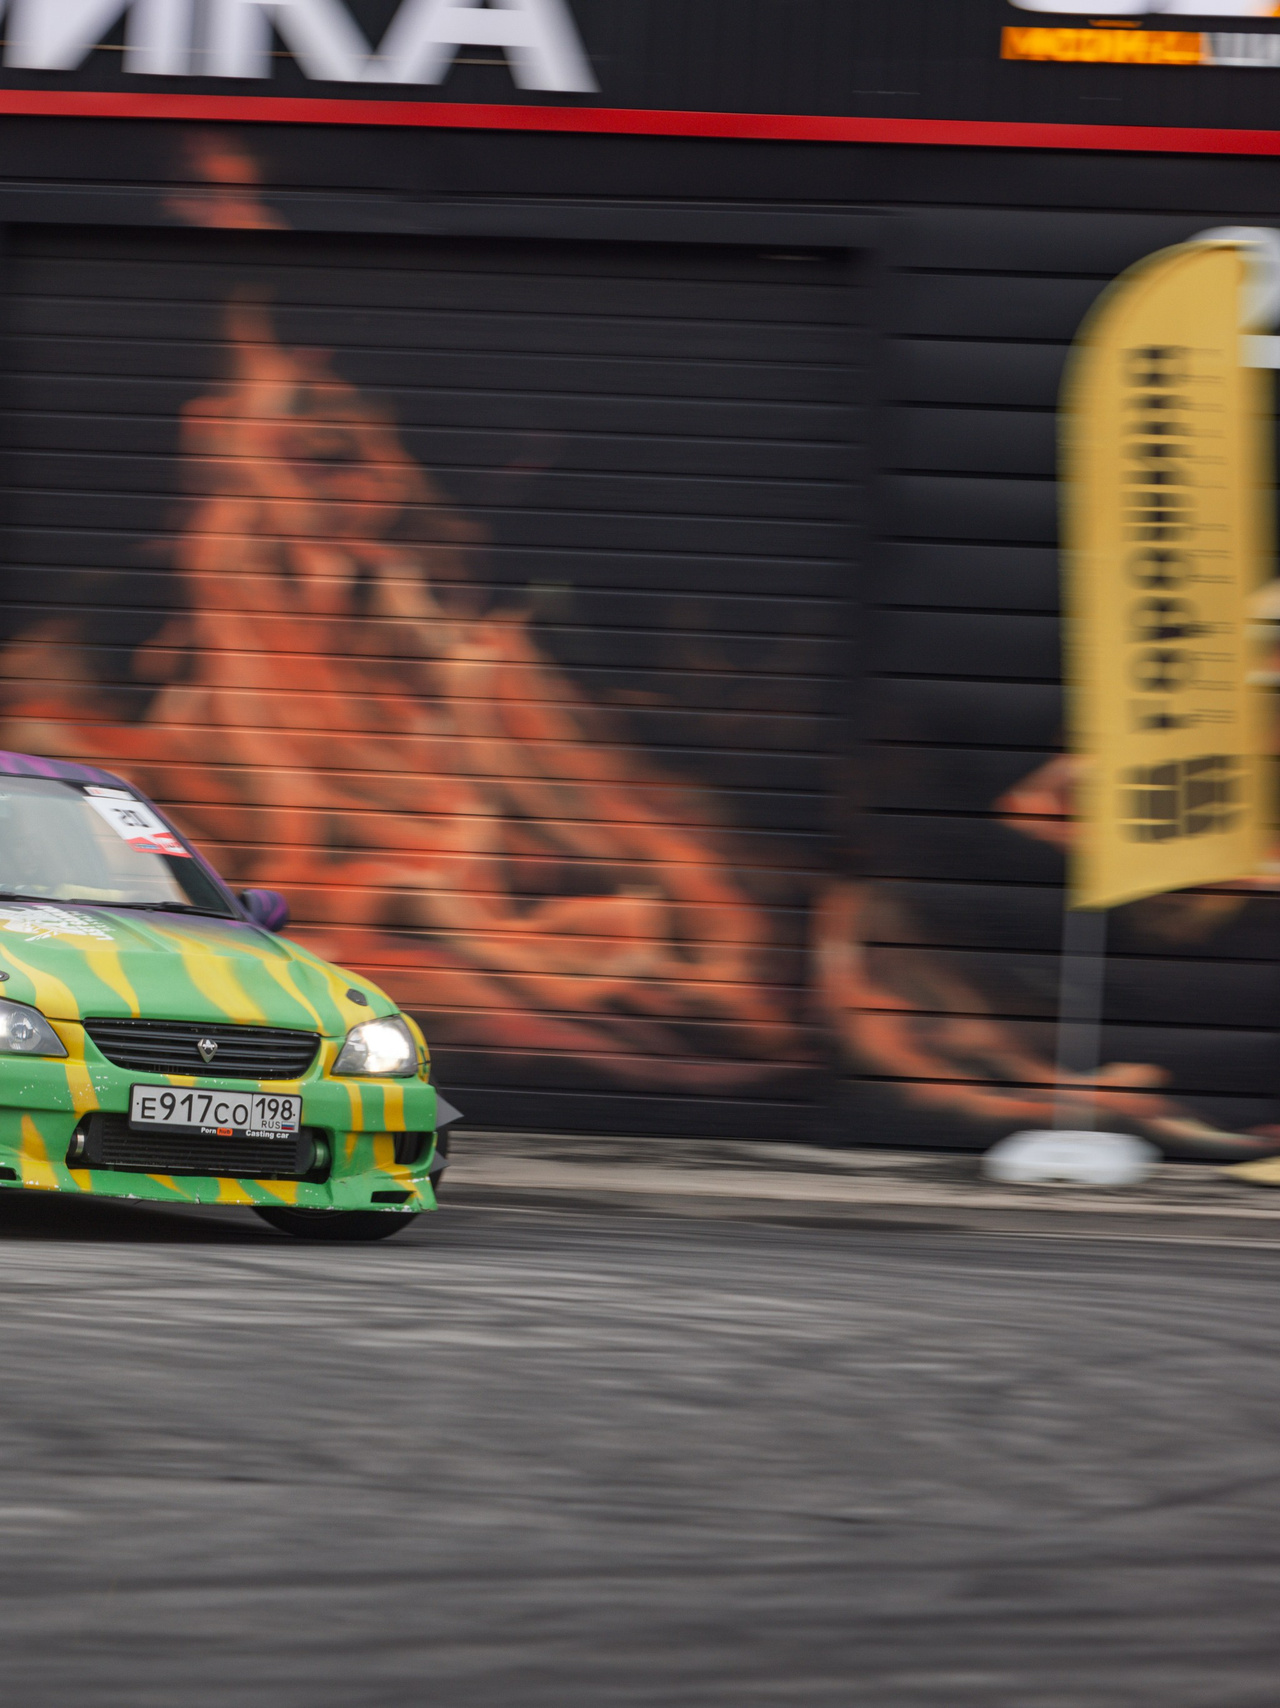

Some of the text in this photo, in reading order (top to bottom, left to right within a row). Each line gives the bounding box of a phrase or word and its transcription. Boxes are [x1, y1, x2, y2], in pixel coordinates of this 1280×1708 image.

[255, 1097, 293, 1121] 198
[261, 1120, 281, 1130] RUS
[245, 1129, 275, 1140] Casting
